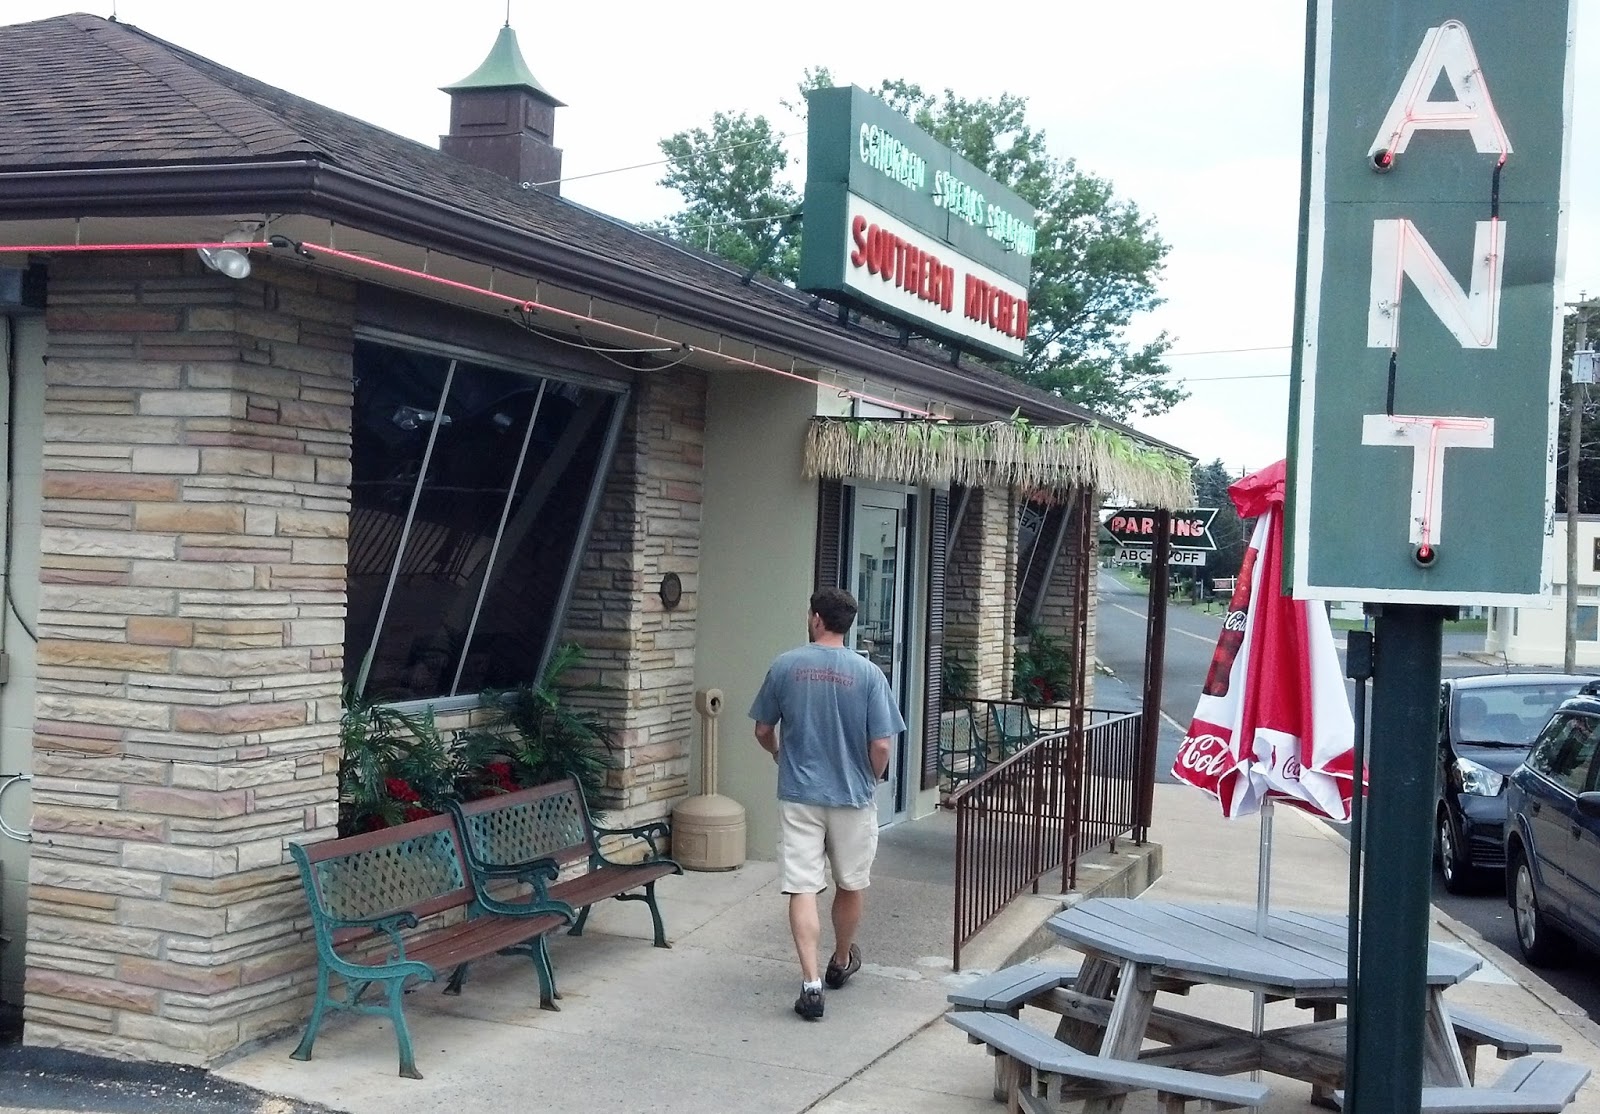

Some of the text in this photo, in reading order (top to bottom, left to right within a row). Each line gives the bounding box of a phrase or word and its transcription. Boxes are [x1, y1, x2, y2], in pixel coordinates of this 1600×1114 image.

[859, 122, 926, 191] CHICKEN
[850, 214, 1029, 341] SOUTHERN KITCHEN
[1111, 516, 1205, 537] PARING
